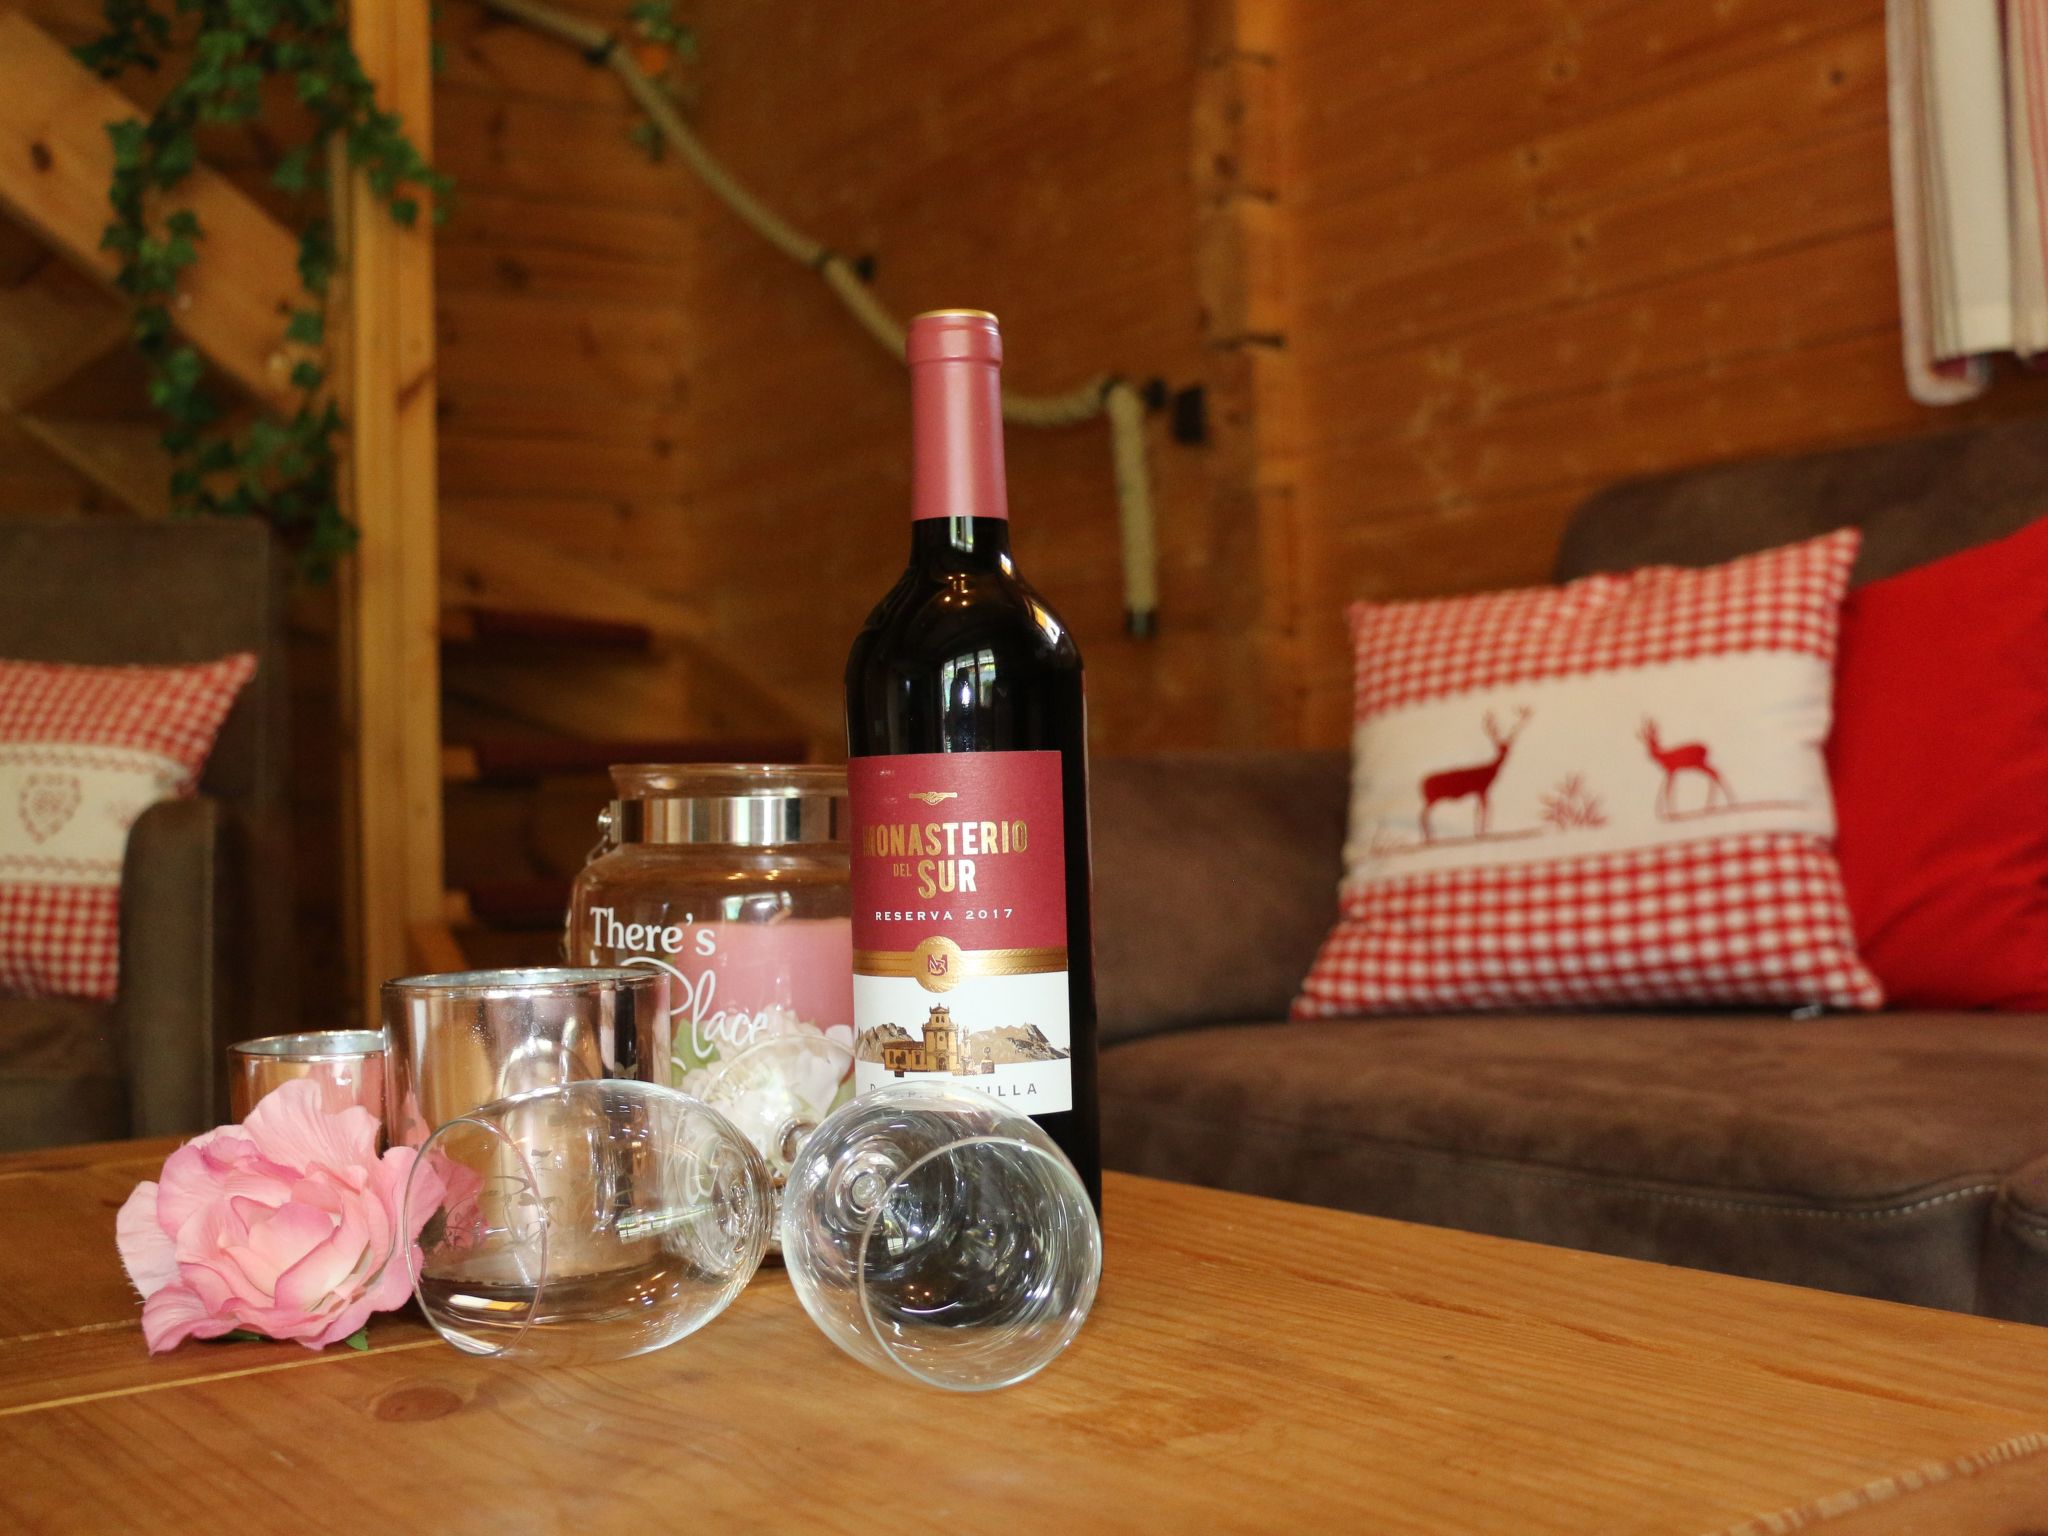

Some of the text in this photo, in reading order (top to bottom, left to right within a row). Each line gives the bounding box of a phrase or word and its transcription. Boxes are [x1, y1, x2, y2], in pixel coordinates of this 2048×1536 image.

[863, 820, 1028, 857] MONASTERIO
[893, 859, 977, 899] DEL SUR
[590, 906, 716, 956] There's
[875, 908, 1013, 922] RESERVA 2017
